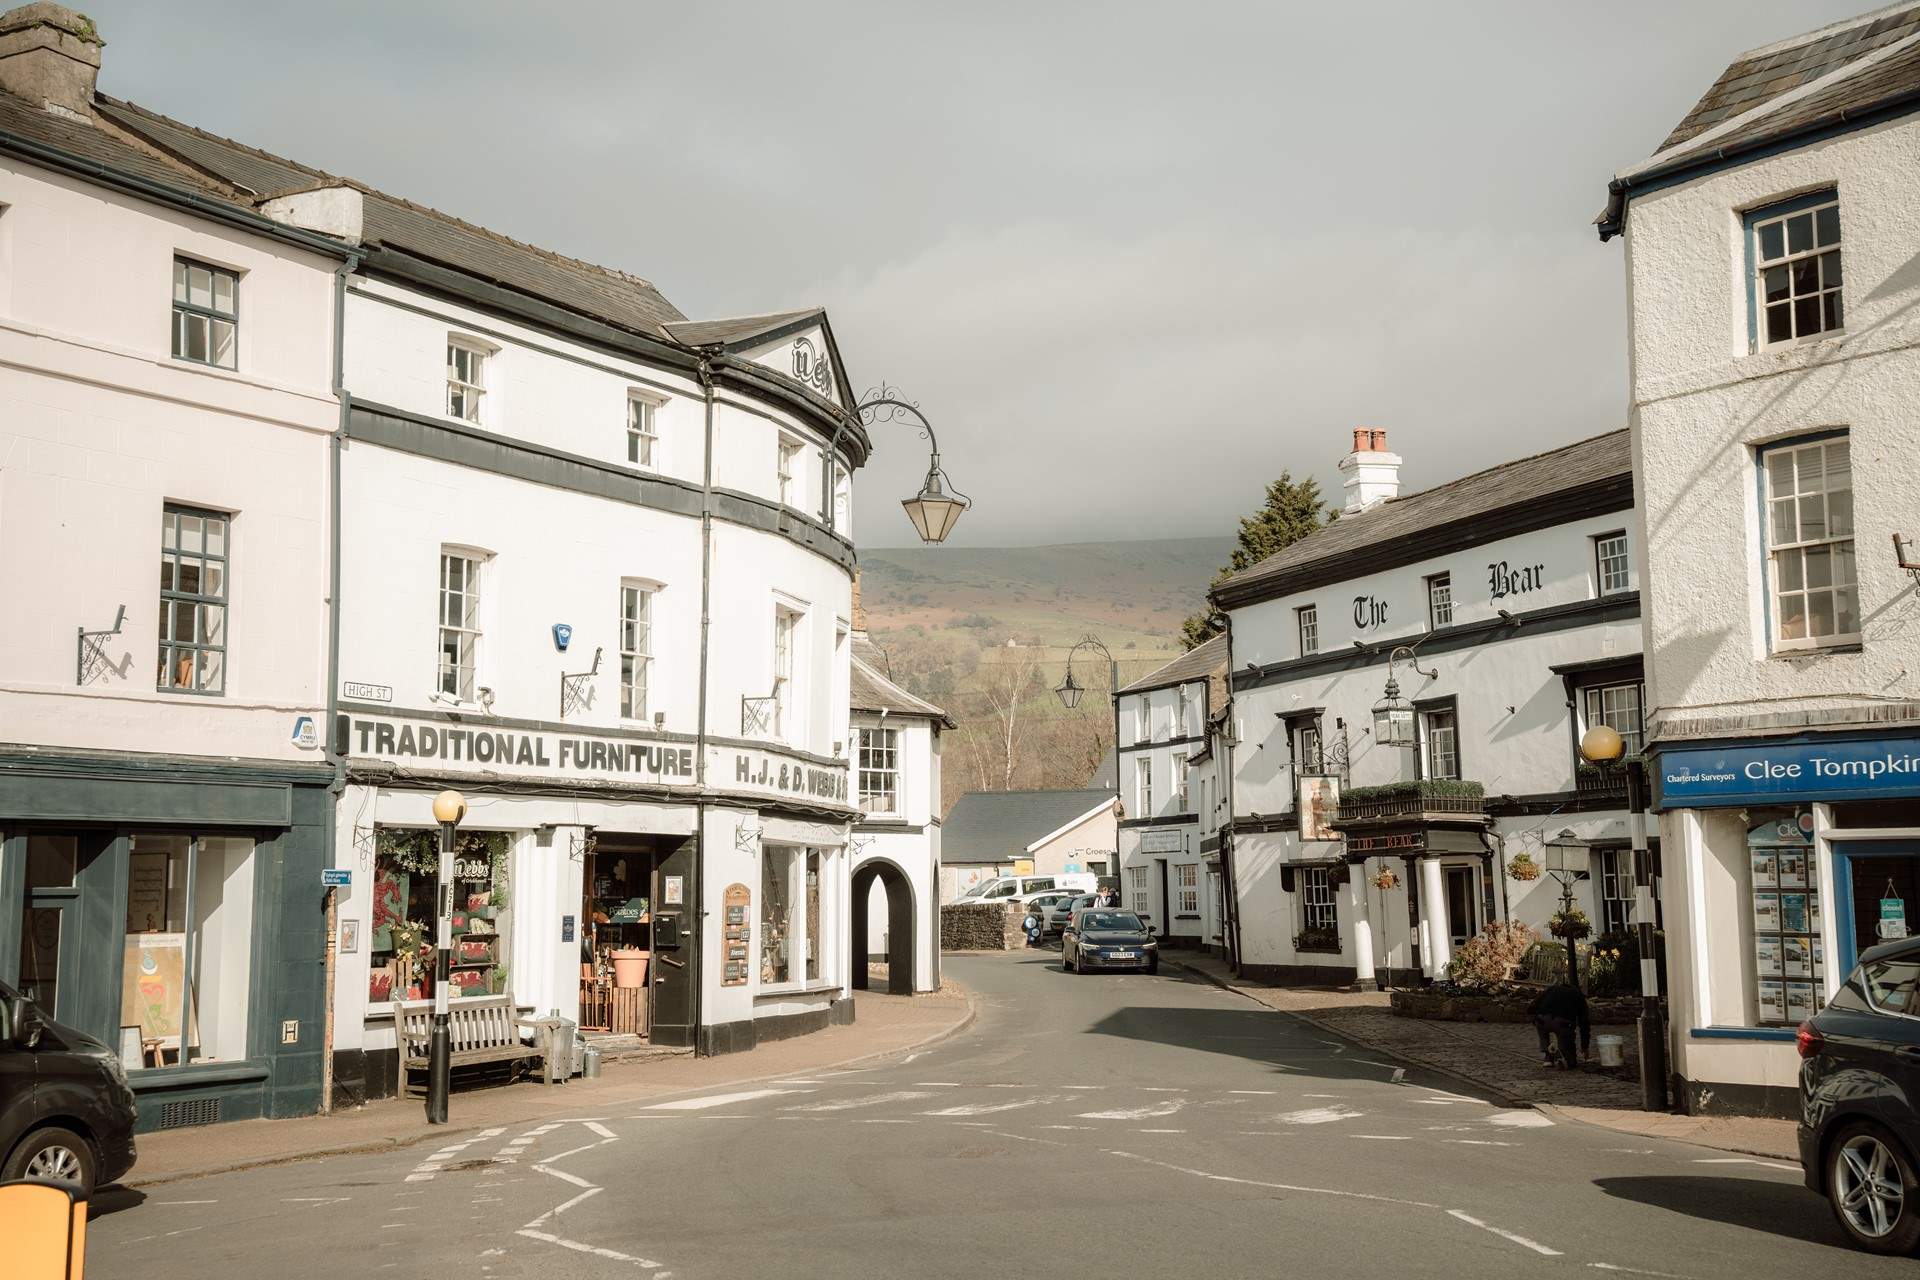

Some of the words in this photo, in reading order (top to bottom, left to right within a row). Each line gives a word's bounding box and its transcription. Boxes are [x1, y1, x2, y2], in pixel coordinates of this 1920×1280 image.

[1353, 595, 1388, 631] The
[1487, 560, 1545, 606] Bear
[348, 685, 373, 697] HIGH
[354, 720, 550, 767] TRADITIONAL
[559, 739, 692, 776] FURNITURE
[1667, 774, 1700, 783] Chartered
[1701, 773, 1736, 783] Surveyors
[1745, 760, 1802, 780] Clee
[778, 763, 789, 790] &
[807, 768, 836, 798] WEBB
[1777, 823, 1800, 837] Cle
[1387, 834, 1412, 849] BEAR
[453, 858, 490, 877] Webbs
[609, 907, 639, 916] Potatoes
